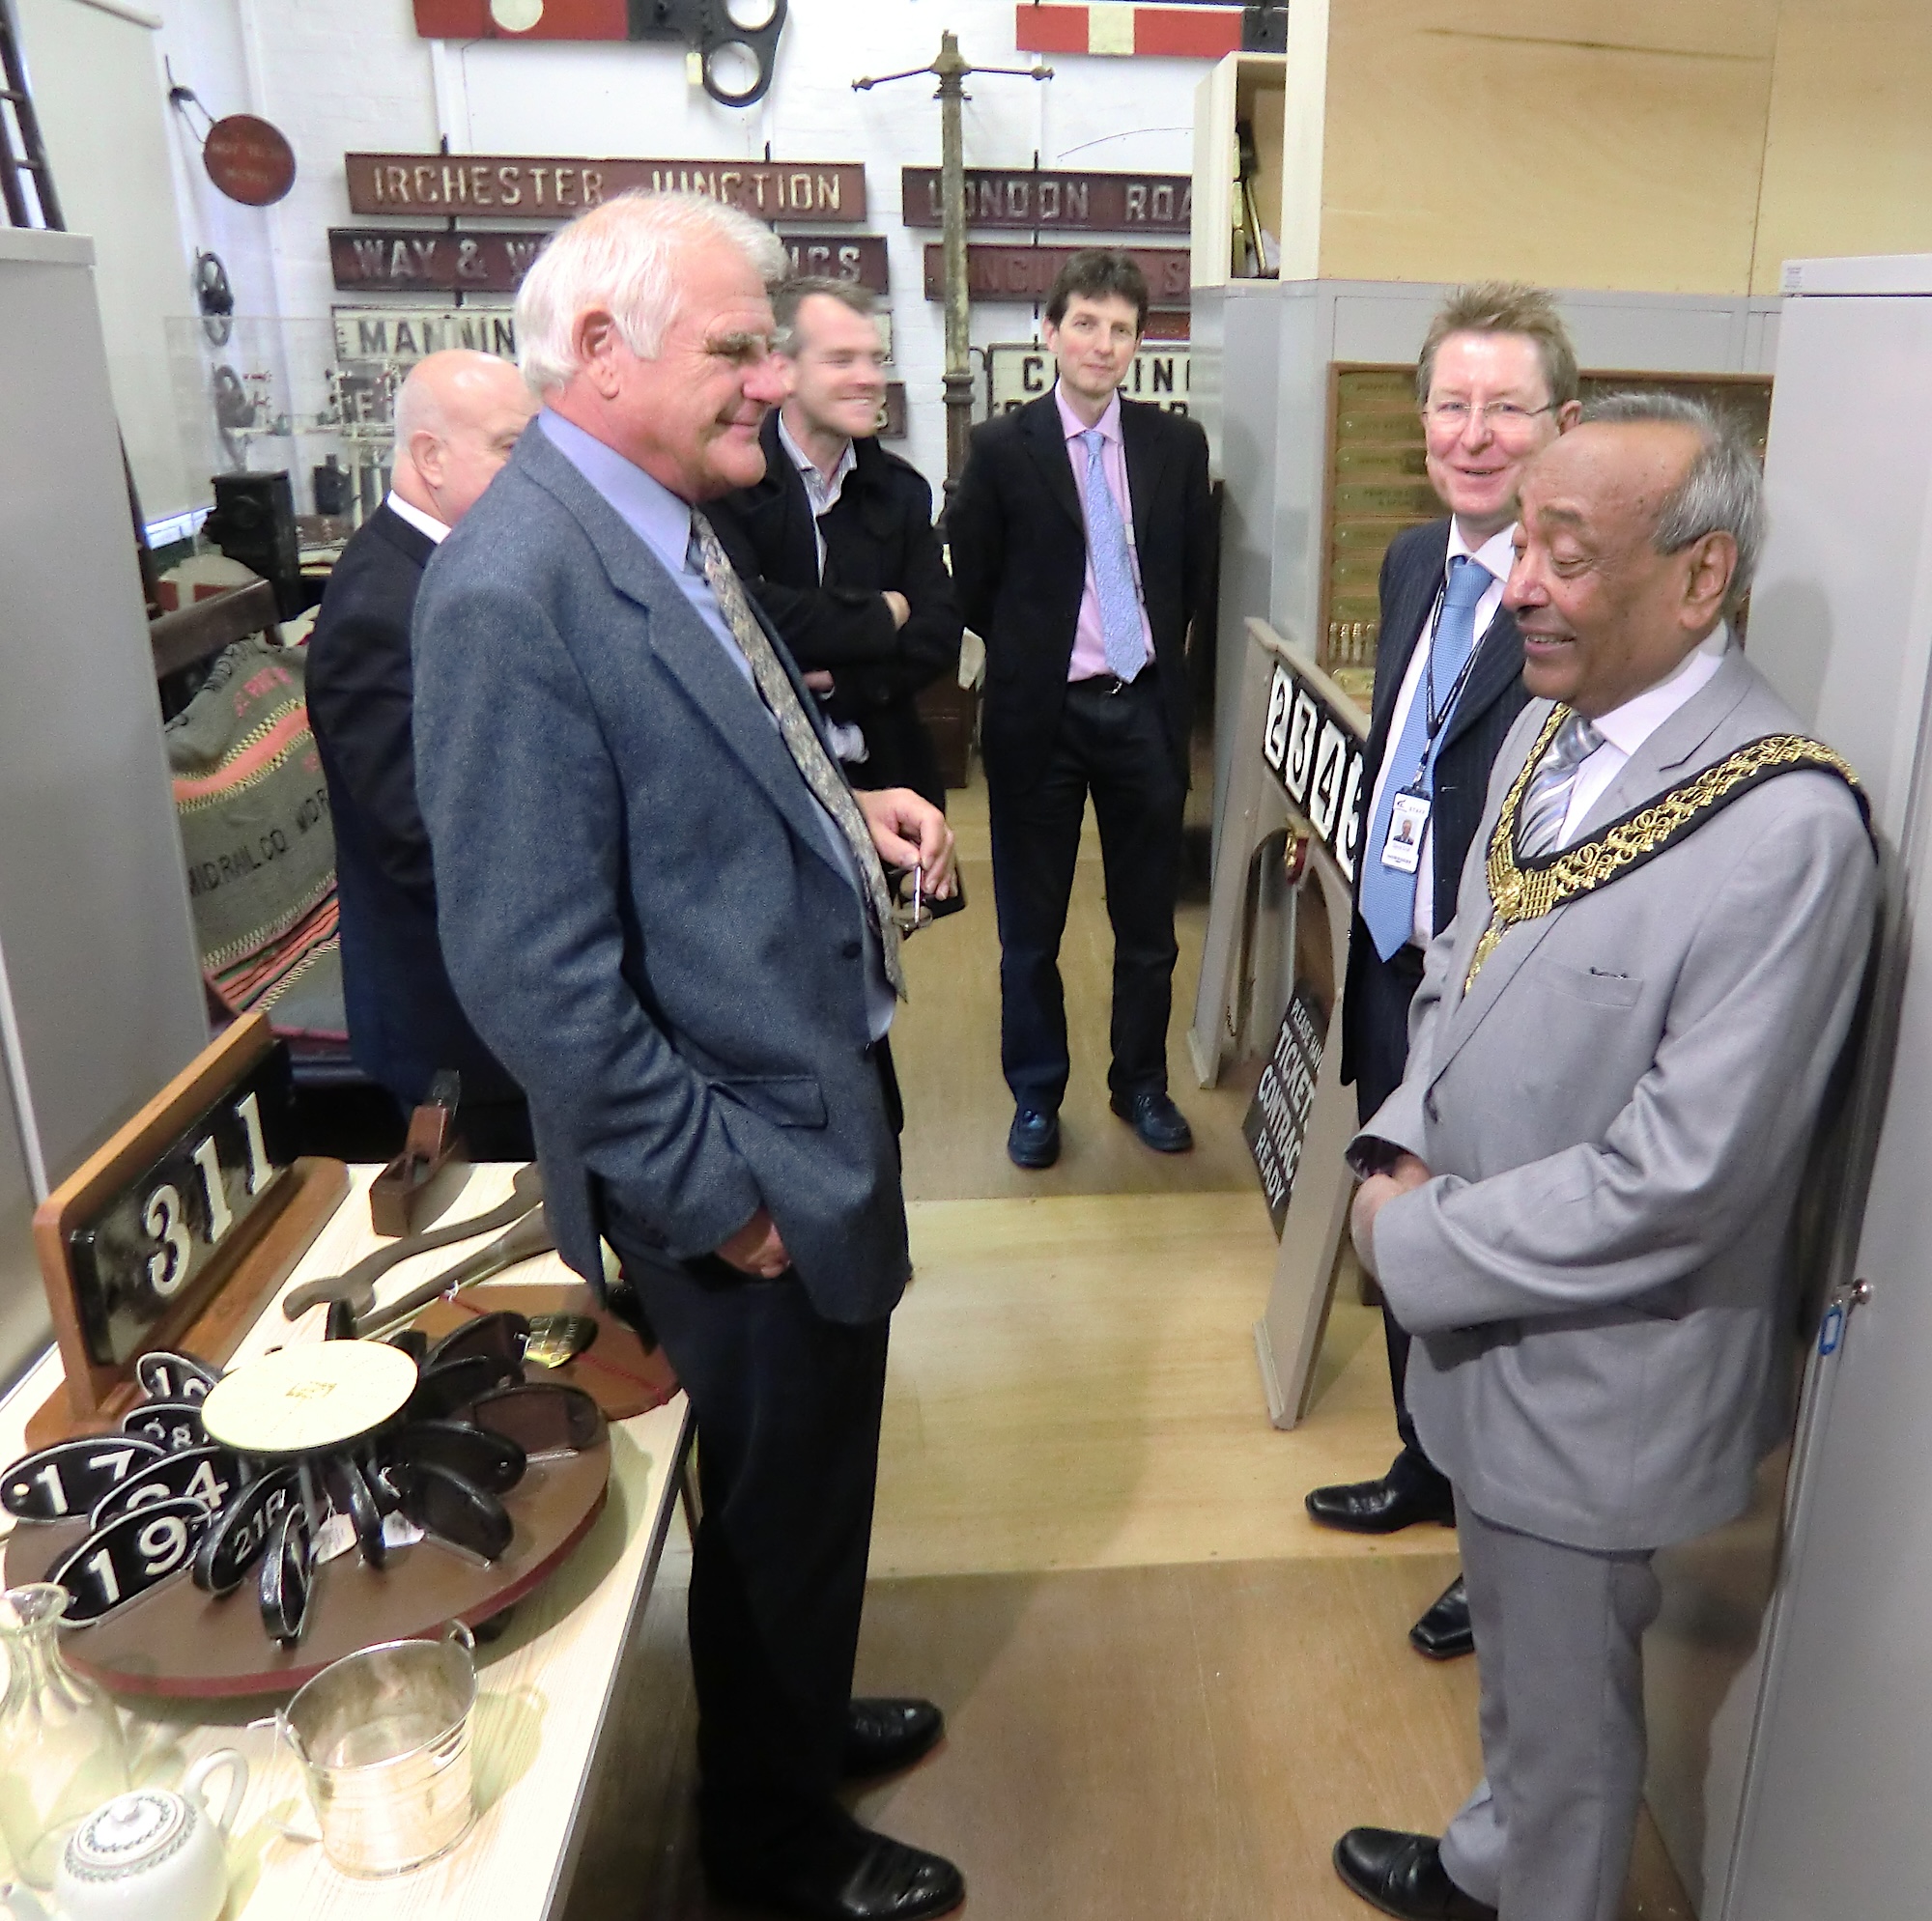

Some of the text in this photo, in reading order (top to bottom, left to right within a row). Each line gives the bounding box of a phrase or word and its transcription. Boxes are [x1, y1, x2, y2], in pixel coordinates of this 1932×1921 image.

[374, 164, 604, 207] IRCHESTER
[354, 239, 436, 278] WAY
[457, 239, 488, 279] &
[1274, 1020, 1316, 1133] TICKET
[1255, 1126, 1286, 1209] READY
[1259, 1064, 1302, 1190] CONTRAC
[143, 1090, 274, 1297] 311
[87, 1514, 188, 1605] 19
